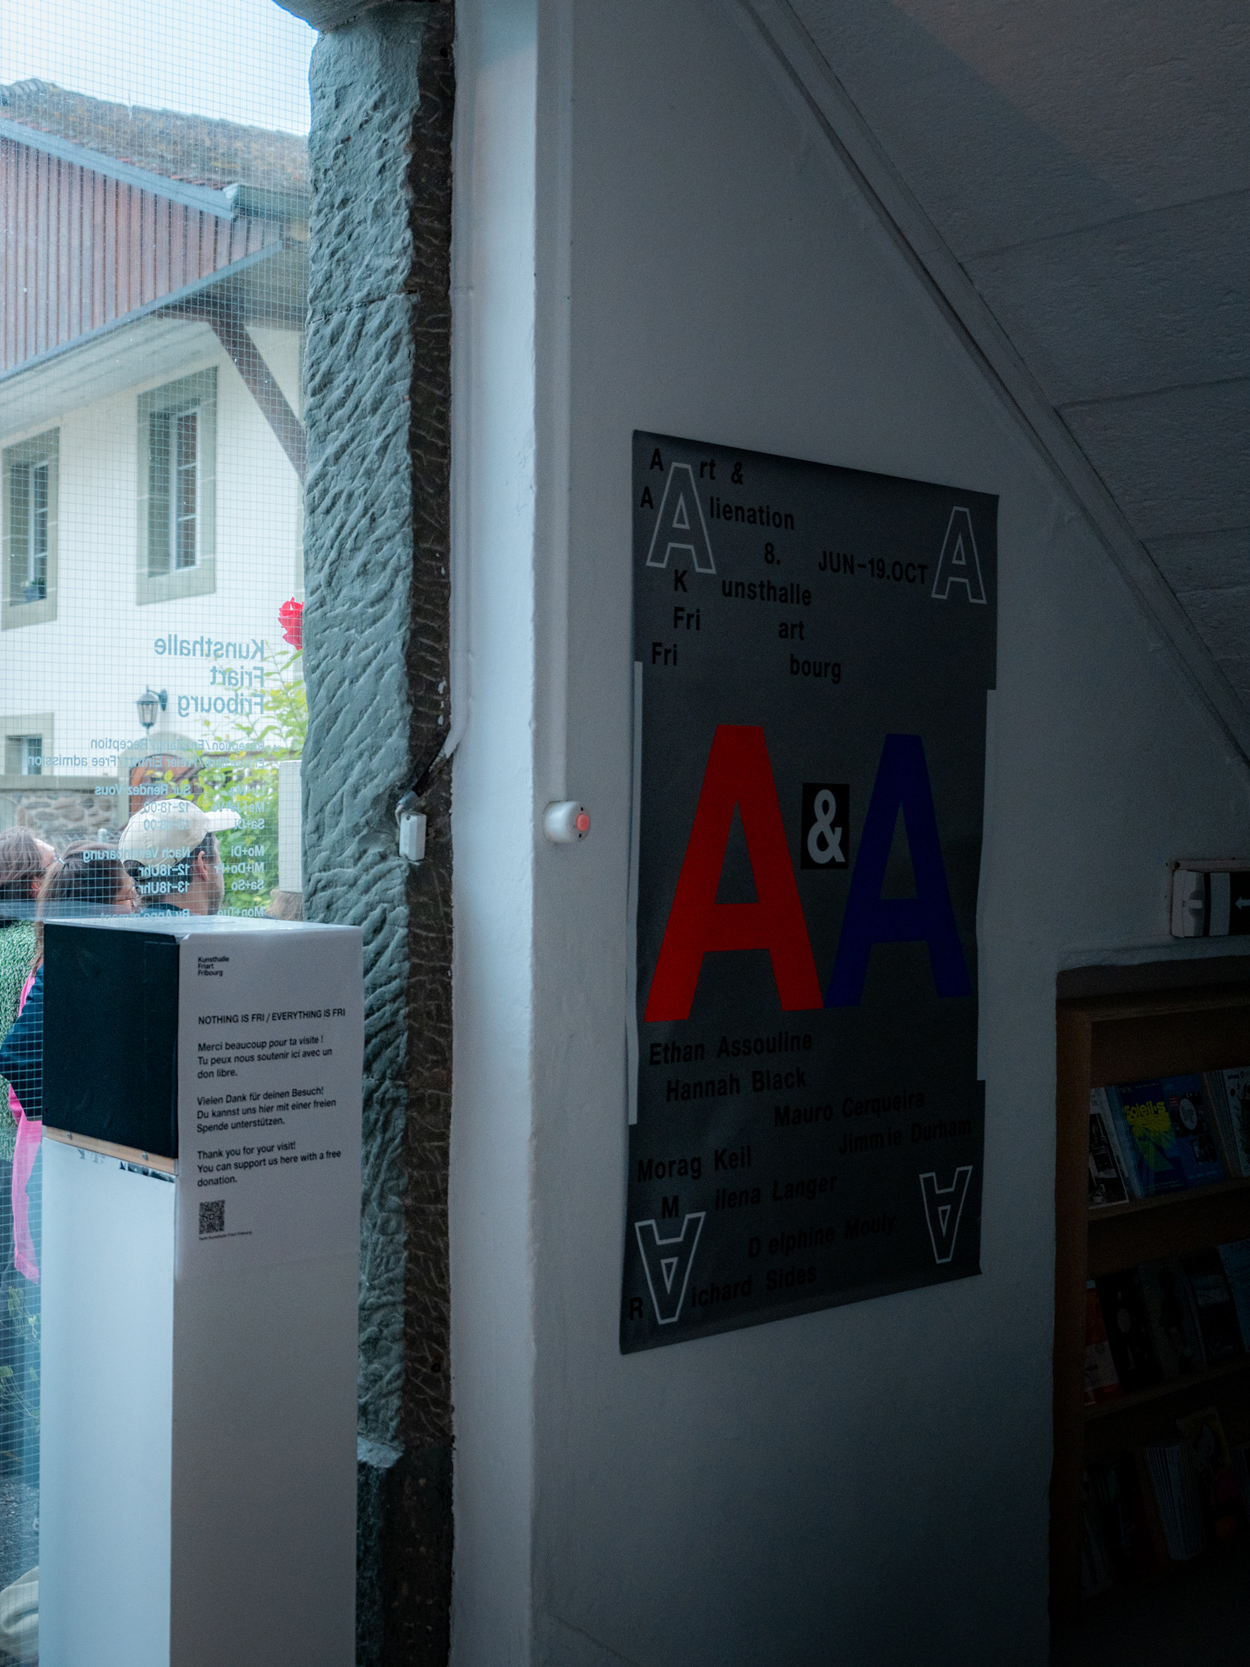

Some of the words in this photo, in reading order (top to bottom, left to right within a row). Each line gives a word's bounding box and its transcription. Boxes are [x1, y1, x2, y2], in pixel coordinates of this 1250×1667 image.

[650, 448, 664, 472] A
[731, 462, 744, 485] &
[640, 486, 653, 510] A
[646, 461, 716, 574] A
[764, 542, 781, 565] 8.
[931, 505, 987, 604] A
[673, 569, 688, 592] K
[673, 607, 700, 631] Fri
[778, 620, 804, 641] art
[652, 642, 677, 666] Fri
[790, 654, 841, 684] bourg
[807, 788, 846, 865] &
[643, 724, 824, 1022] A
[824, 733, 972, 1008] A
[198, 969, 223, 977] Fribourg
[198, 1015, 239, 1025] NOTHING
[241, 1014, 249, 1023] IS
[251, 1013, 265, 1022] FRI
[272, 1010, 321, 1021] EVERYTHING
[323, 1009, 331, 1018] IS
[332, 1008, 345, 1017] FRI
[198, 1042, 223, 1051] Merci
[225, 1039, 267, 1051] beaucoup
[269, 1038, 287, 1049] pour
[289, 1037, 297, 1046] ta
[299, 1035, 319, 1045] visite
[649, 1040, 704, 1066] Ethan
[717, 1031, 812, 1059] Assouline
[198, 1055, 209, 1065] Tu
[211, 1055, 232, 1066] peux
[234, 1053, 254, 1063] nous
[257, 1050, 289, 1062] soutenir
[291, 1049, 300, 1059] ici
[302, 1049, 320, 1058] avec
[322, 1048, 332, 1056] un
[198, 1069, 214, 1079] don
[216, 1067, 237, 1078] libre.
[666, 1073, 740, 1102] Hannah
[752, 1067, 806, 1092] Black
[197, 1095, 223, 1106] Vielen
[226, 1092, 247, 1104] Dank
[249, 1091, 261, 1101] für
[263, 1089, 290, 1100] deinen
[292, 1087, 324, 1098] Besuch!
[197, 1109, 209, 1119] Du
[212, 1106, 238, 1118] kannst
[241, 1105, 257, 1115] uns
[258, 1103, 275, 1113] hier
[277, 1102, 289, 1112] mit
[291, 1101, 311, 1111] einer
[313, 1099, 336, 1109] freien
[774, 1103, 833, 1127] Mauro
[842, 1089, 924, 1118] Cerqueira
[197, 1121, 228, 1134] Spende
[231, 1116, 285, 1130] unterstützen.
[911, 1118, 972, 1144] Durham
[197, 1148, 223, 1160] Thank
[226, 1148, 240, 1159] you
[243, 1145, 254, 1156] for
[257, 1145, 275, 1155] your
[277, 1141, 296, 1152] visit!
[197, 1163, 215, 1174] You
[217, 1162, 232, 1172] can
[234, 1158, 266, 1172] support
[268, 1156, 278, 1166] us
[280, 1154, 298, 1165] here
[300, 1152, 317, 1162] with
[326, 1149, 341, 1160] free
[637, 1153, 701, 1182] Morag
[714, 1146, 752, 1171] Keil
[197, 1175, 237, 1187] donation.
[662, 1196, 679, 1219] M
[773, 1173, 837, 1202] Langer
[845, 1213, 896, 1238] Mouly
[629, 1297, 643, 1321] R
[766, 1265, 817, 1292] Sides
